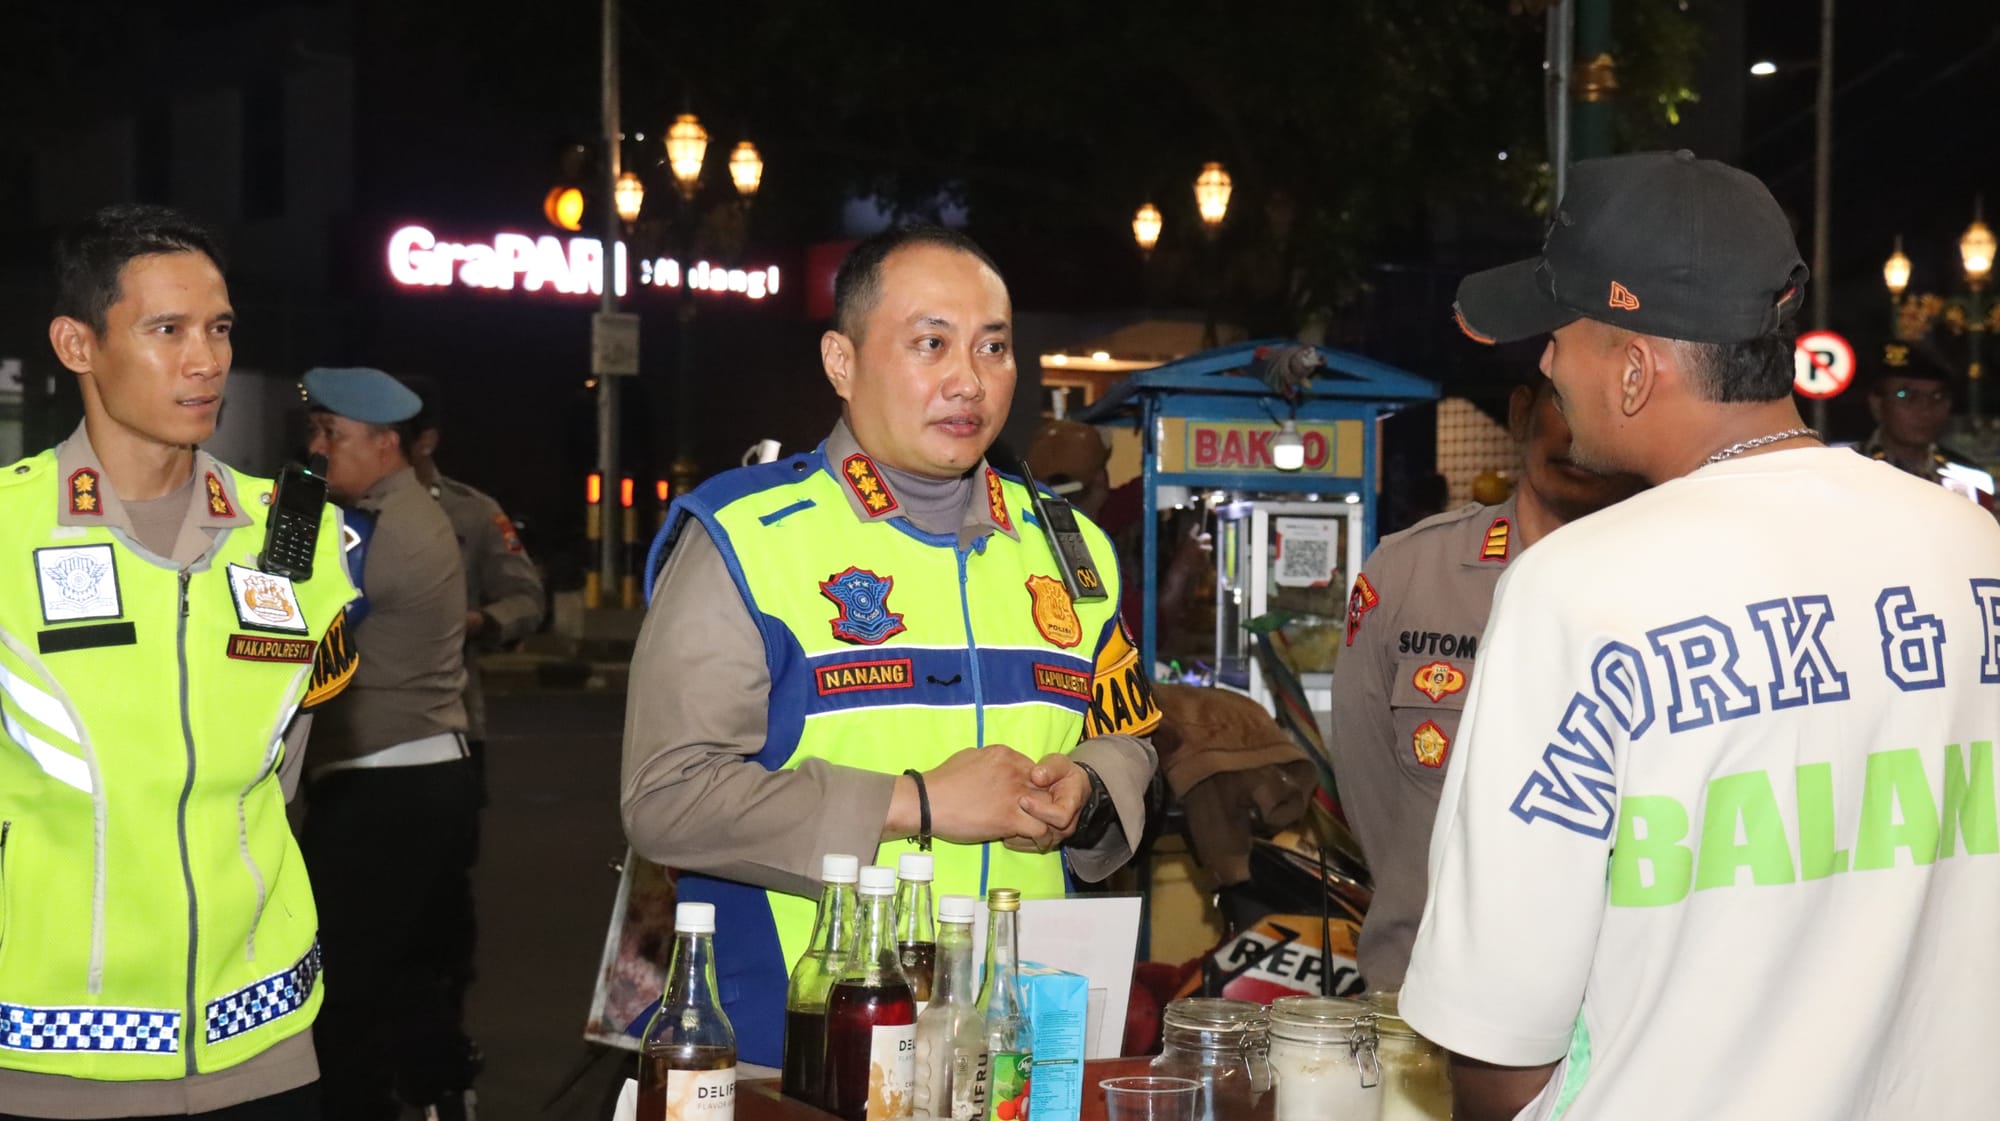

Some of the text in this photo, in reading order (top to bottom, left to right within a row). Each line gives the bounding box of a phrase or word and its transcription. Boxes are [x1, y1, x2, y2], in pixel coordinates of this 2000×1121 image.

[1809, 349, 1835, 381] P
[1195, 428, 1326, 468] BAKO
[235, 640, 310, 659] WAKAPOLRESTA
[1399, 630, 1477, 659] SUTOM
[825, 664, 905, 688] NANANG
[1509, 593, 1850, 840] WORK
[1874, 585, 1946, 692] &
[1610, 740, 1999, 908] BALAN
[969, 1053, 989, 1121] LIFRU
